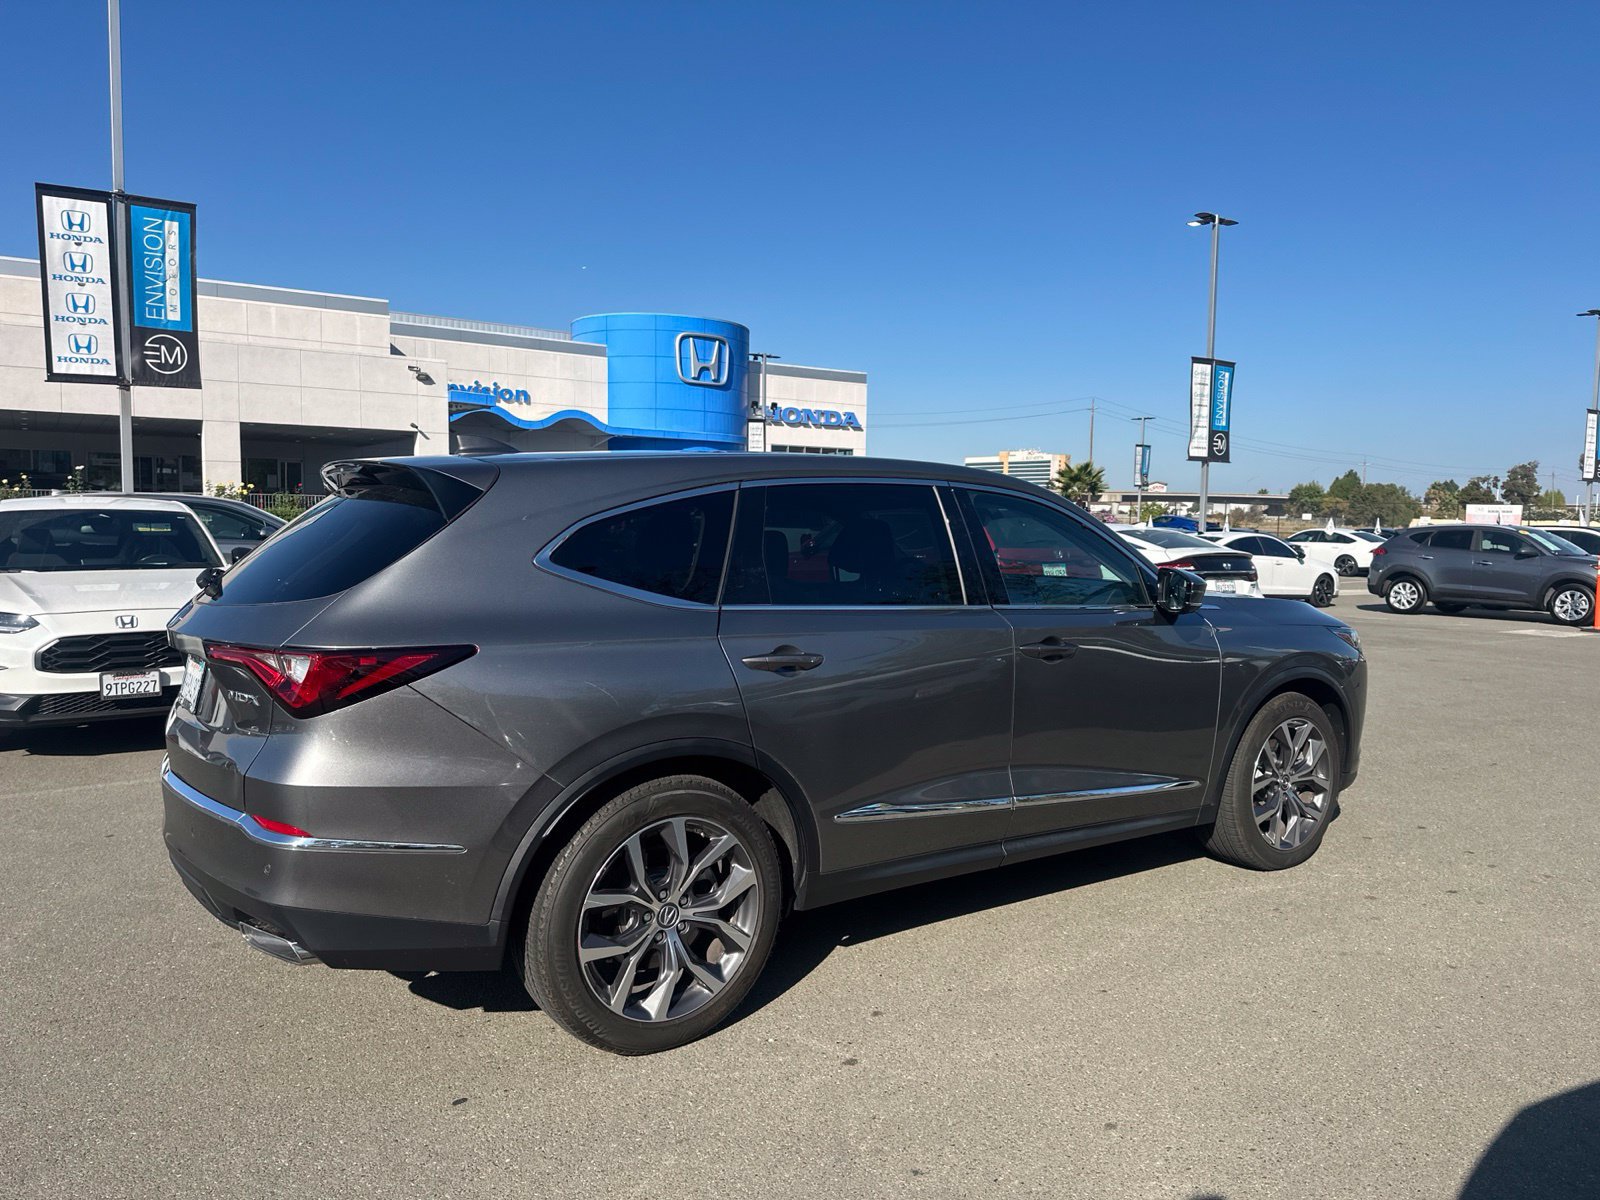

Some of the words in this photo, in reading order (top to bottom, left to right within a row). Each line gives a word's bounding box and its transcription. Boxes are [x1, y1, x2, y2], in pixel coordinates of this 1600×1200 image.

[49, 232, 104, 244] HONDA
[144, 217, 165, 319] ENVISION
[168, 230, 178, 312] MOTORS
[51, 273, 106, 285] HONDA
[54, 315, 109, 325] HONDA
[56, 355, 111, 365] HONDA
[1215, 370, 1226, 426] ENVISION
[105, 680, 157, 696] 9TPG227
[228, 690, 260, 706] MDX
